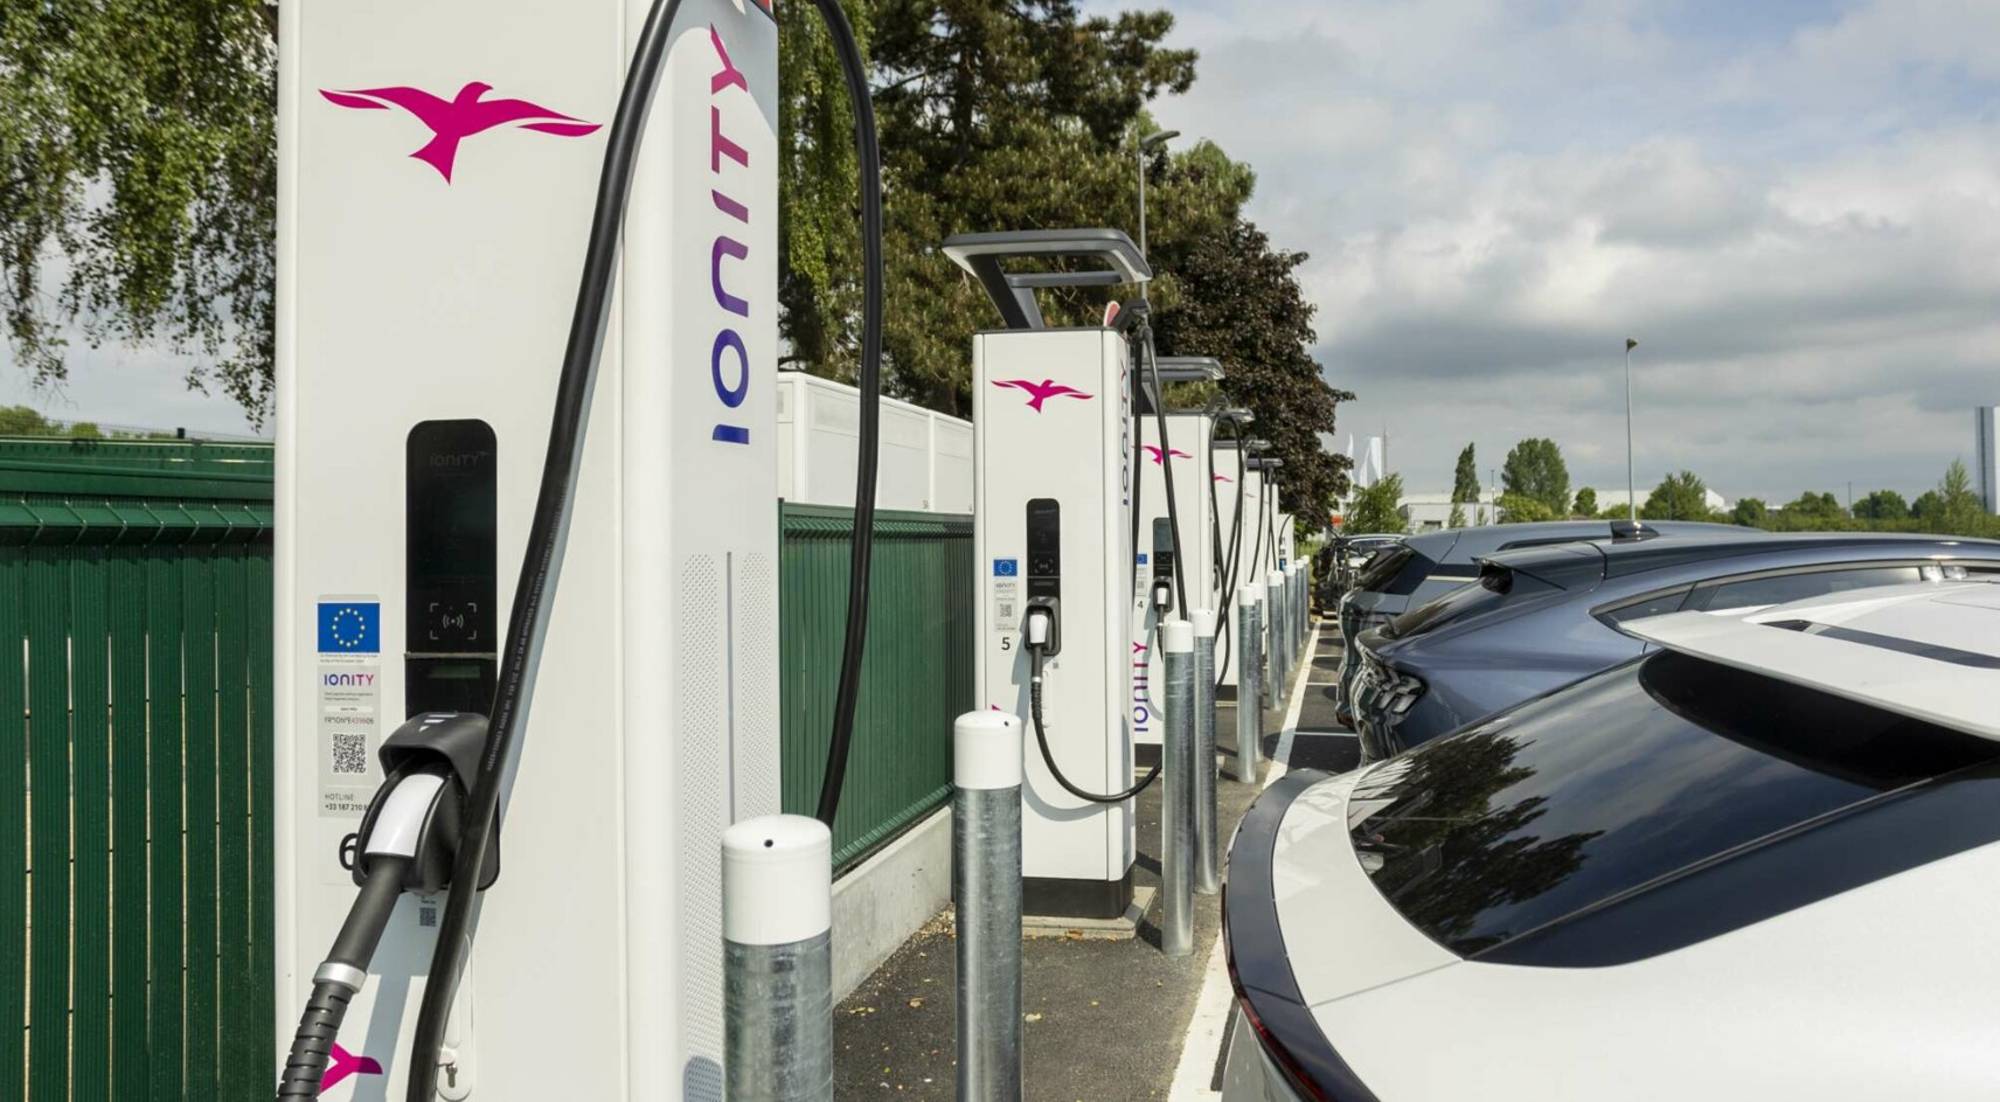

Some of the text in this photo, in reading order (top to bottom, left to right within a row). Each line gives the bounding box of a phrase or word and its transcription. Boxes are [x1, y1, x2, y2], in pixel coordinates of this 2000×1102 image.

[710, 22, 749, 446] IONITY
[1137, 600, 1144, 609] 4
[1001, 637, 1010, 650] 5
[324, 673, 374, 686] IONITY
